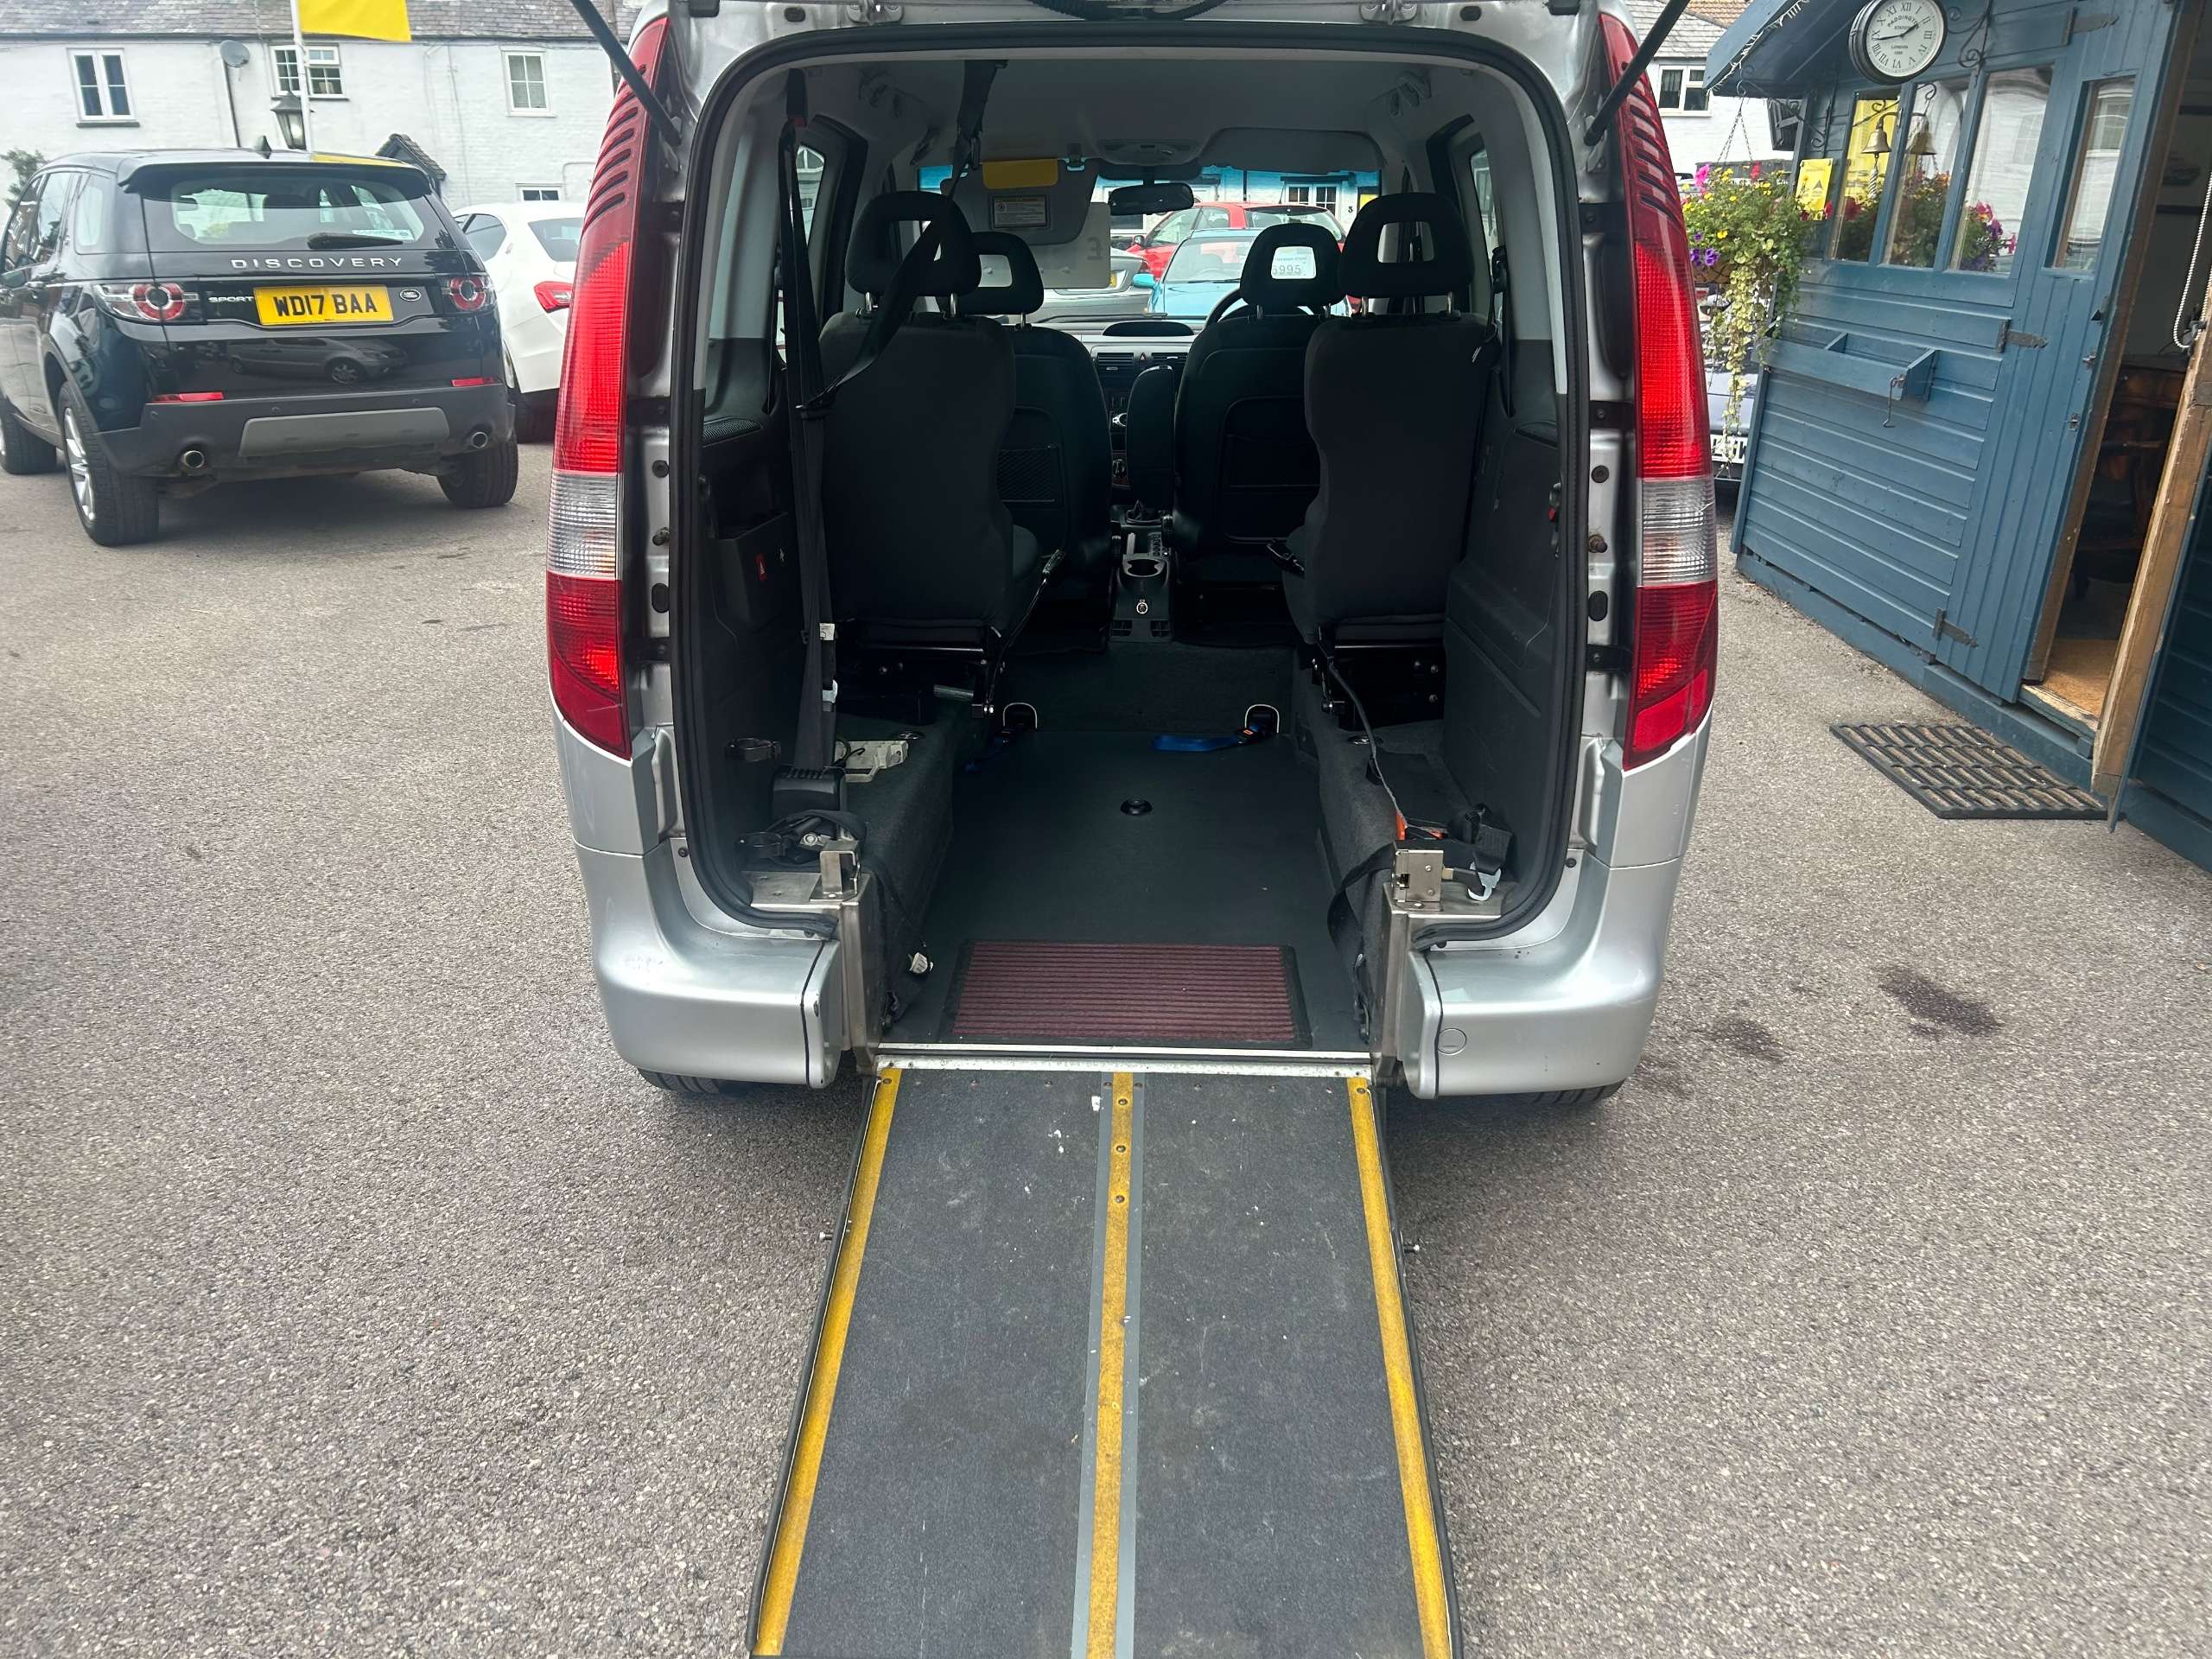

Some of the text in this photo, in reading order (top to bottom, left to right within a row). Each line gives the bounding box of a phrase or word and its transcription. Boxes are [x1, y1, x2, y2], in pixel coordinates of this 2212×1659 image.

[1887, 5, 1897, 15] XI
[1902, 2, 1912, 11] XII
[1923, 16, 1931, 24] II
[1923, 30, 1933, 40] III
[1872, 43, 1881, 56] VIII
[1878, 53, 1889, 66] VII
[1892, 58, 1901, 69] VI
[231, 257, 402, 269] DISCOVERY
[273, 293, 378, 317] WD17 BAA
